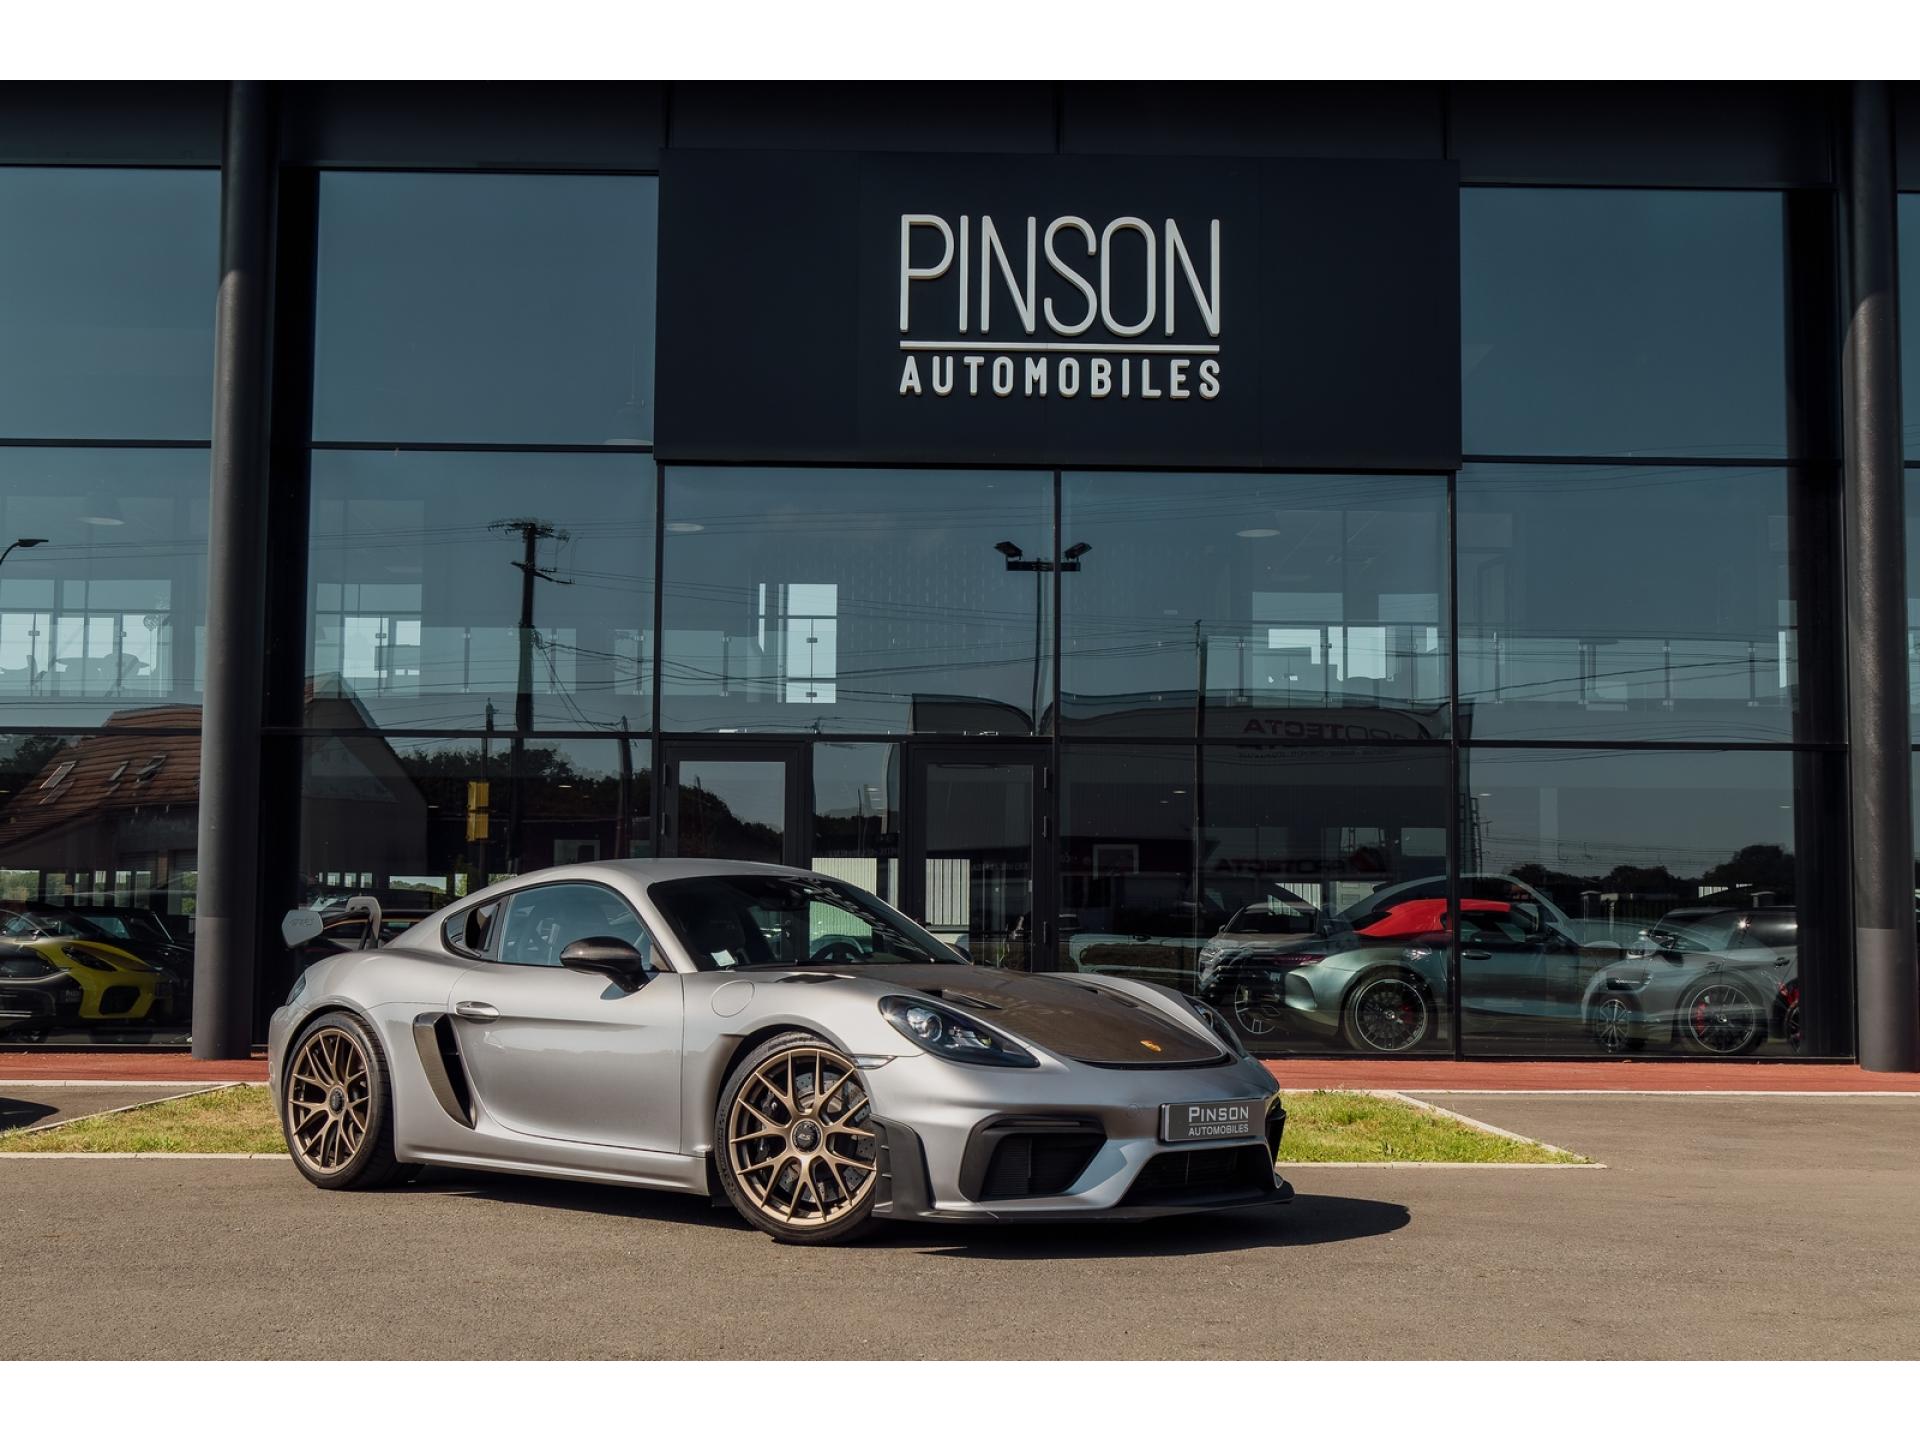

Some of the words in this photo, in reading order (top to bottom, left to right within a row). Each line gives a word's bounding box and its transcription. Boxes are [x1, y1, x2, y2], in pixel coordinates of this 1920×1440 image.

[900, 214, 1220, 337] PINSON
[900, 355, 1220, 399] AUTOMOBILES
[1188, 1106, 1249, 1122] PINSON
[1188, 1124, 1249, 1136] AUTOMOBILES
